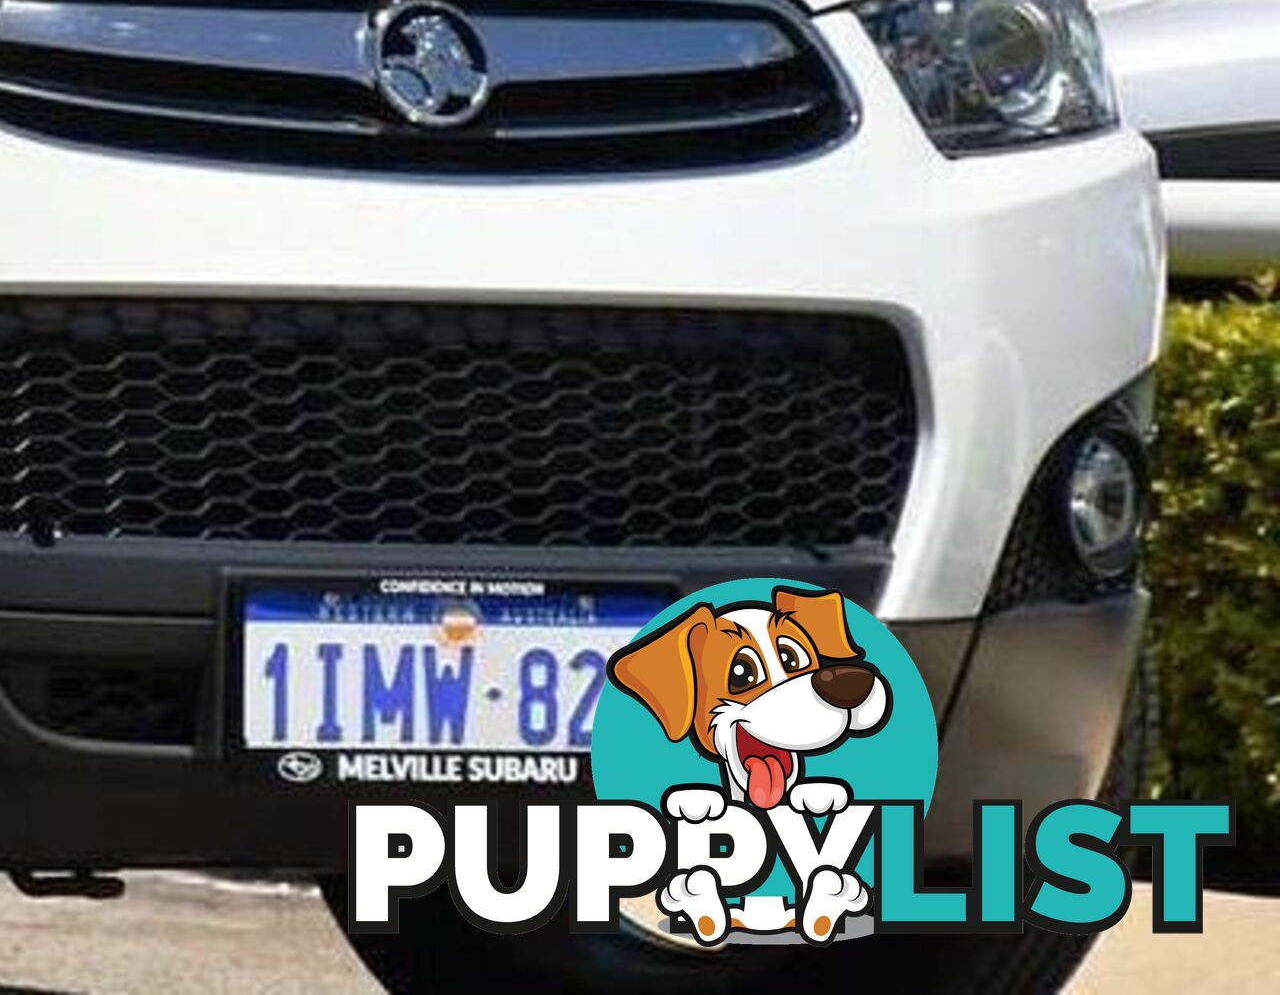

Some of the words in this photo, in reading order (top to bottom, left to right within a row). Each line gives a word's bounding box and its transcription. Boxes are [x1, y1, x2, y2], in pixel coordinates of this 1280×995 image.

[469, 581, 485, 594] IN
[488, 581, 545, 595] MOTION
[337, 753, 462, 782] MELVILLE
[468, 755, 578, 783] SUBARU
